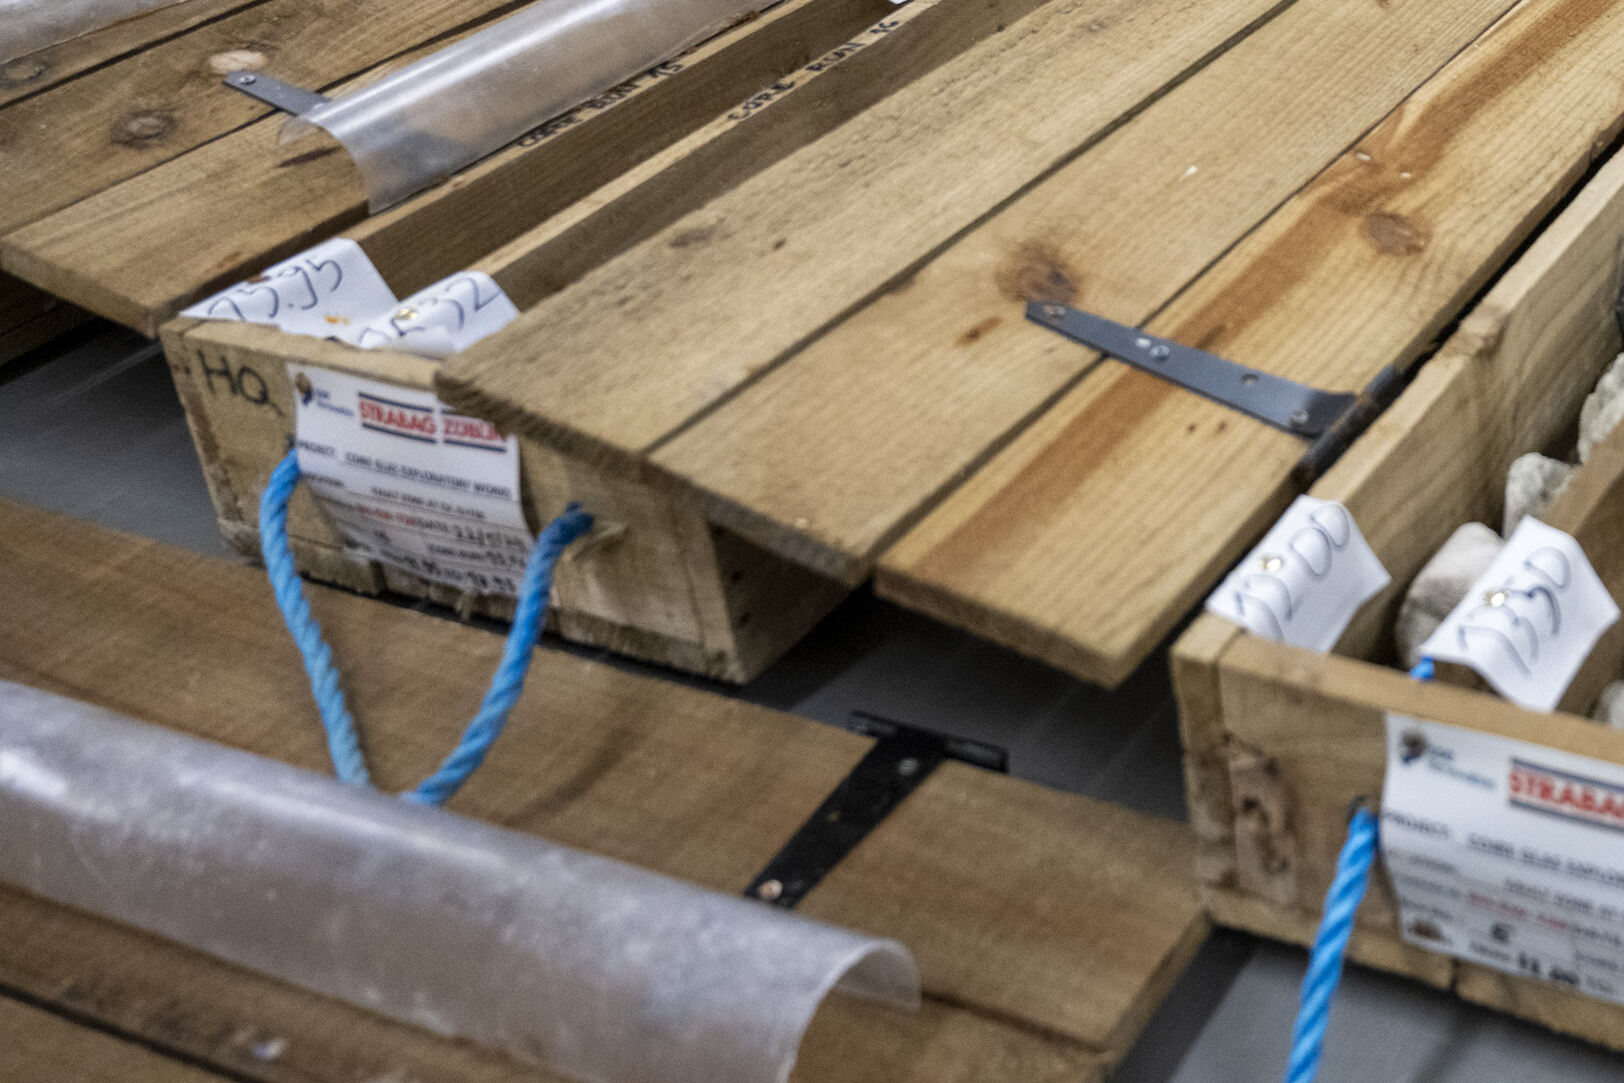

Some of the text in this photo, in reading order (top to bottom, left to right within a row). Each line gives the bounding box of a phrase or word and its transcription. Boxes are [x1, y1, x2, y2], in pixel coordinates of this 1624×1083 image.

[727, 80, 796, 120] CORE
[804, 42, 867, 72] RUN
[195, 348, 284, 418] HQ
[358, 400, 438, 436] STRABAG
